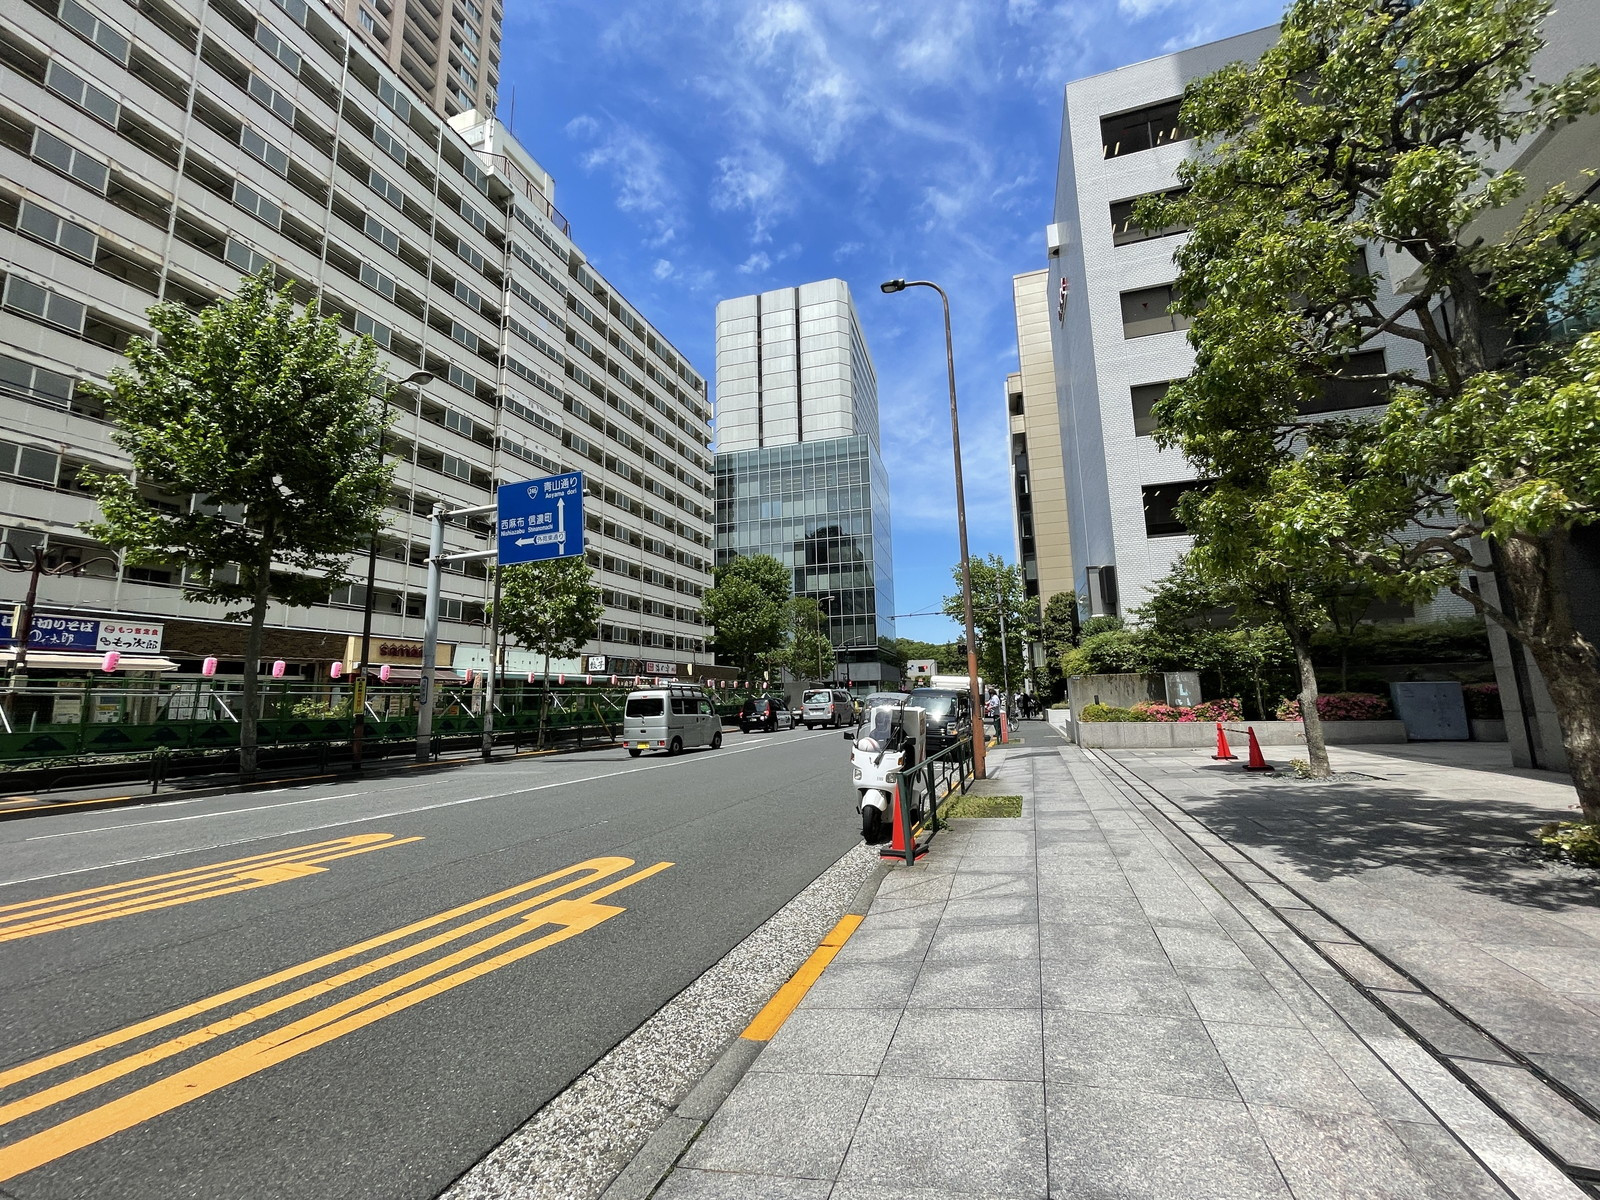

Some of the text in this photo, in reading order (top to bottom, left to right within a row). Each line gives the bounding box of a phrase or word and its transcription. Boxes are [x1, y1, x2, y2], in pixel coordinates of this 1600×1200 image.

[543, 477, 578, 492] 青山通り
[501, 512, 553, 530] 西麻布 信濃町
[528, 524, 553, 532] Shinanomachi
[112, 636, 159, 650] もつ次郎
